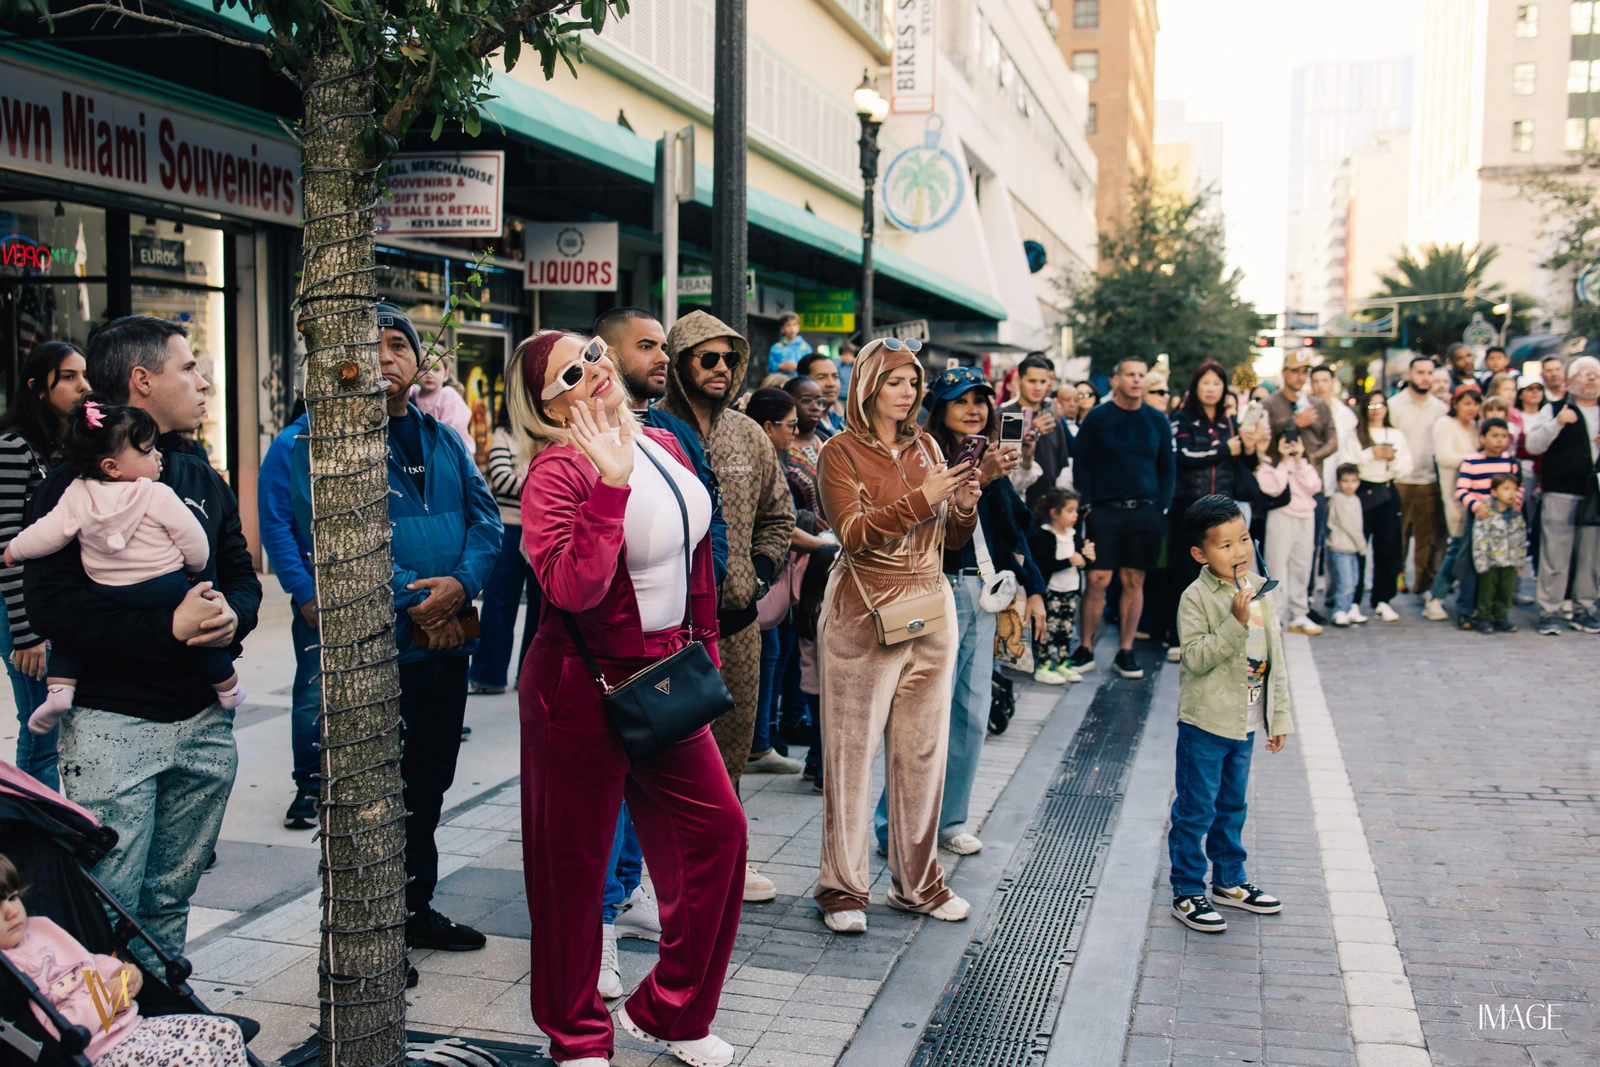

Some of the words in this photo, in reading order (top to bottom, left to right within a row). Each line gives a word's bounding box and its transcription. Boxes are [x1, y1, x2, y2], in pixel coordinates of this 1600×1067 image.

[897, 24, 916, 91] BIKES
[0, 96, 52, 164] wn
[62, 91, 147, 184] Miami
[158, 117, 294, 216] Souveniers
[411, 160, 494, 186] MERCHANDISE
[457, 177, 466, 188] &
[424, 192, 456, 204] SHOP
[436, 206, 444, 216] &
[449, 205, 491, 216] RETAIL
[411, 219, 435, 229] KEYS
[438, 219, 462, 228] MADE
[466, 219, 491, 227] HERE
[140, 248, 178, 267] EUROS
[528, 260, 612, 286] LIQUORS
[802, 313, 844, 329] REPAIR
